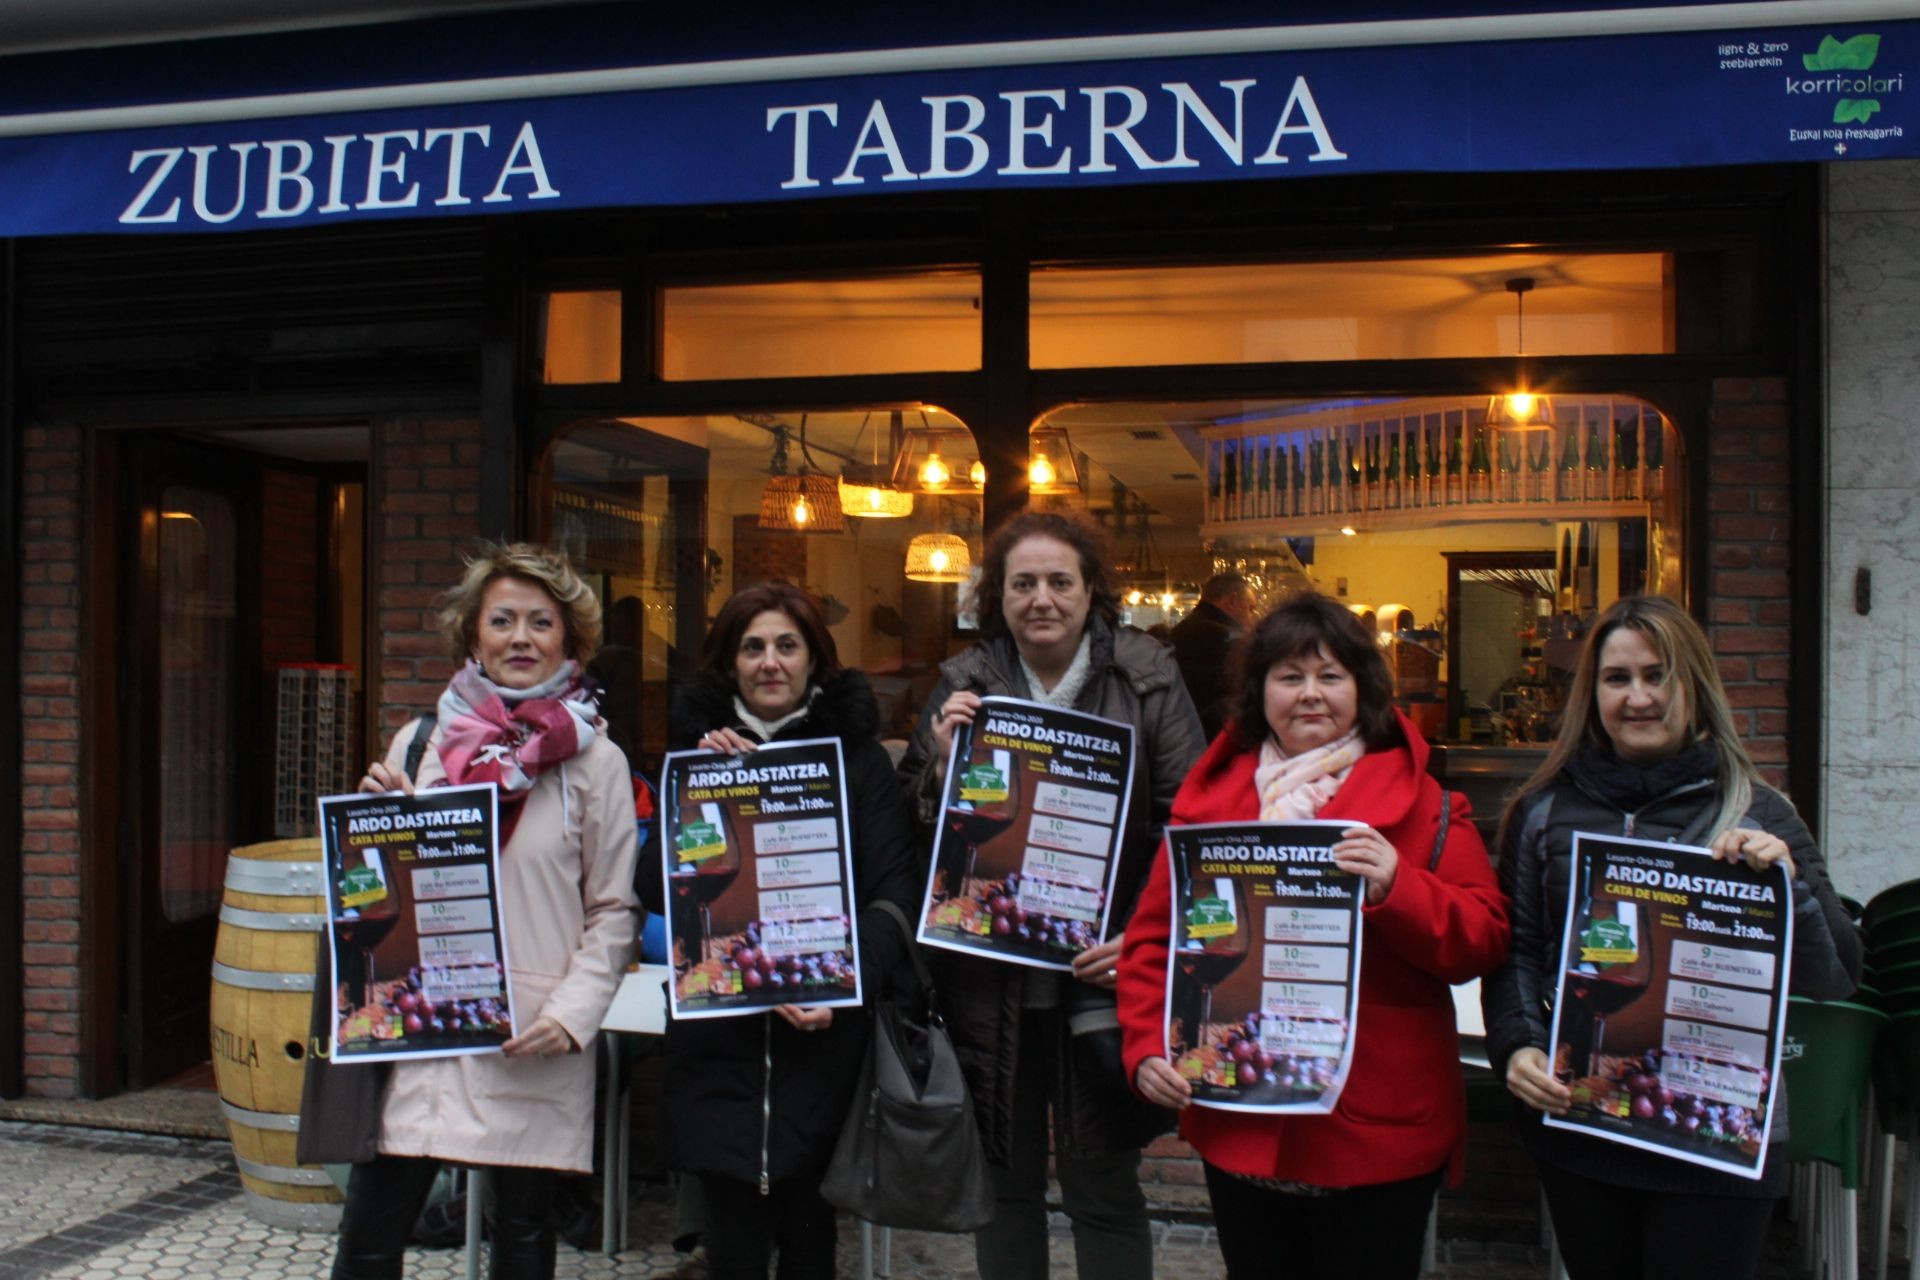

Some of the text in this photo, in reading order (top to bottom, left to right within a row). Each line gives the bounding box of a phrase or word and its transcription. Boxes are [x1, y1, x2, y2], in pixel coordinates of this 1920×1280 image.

[1718, 42, 1789, 56] light & zero
[1720, 57, 1783, 69] stebiarekin
[1786, 73, 1902, 95] korricolari
[1789, 126, 1902, 142] Euskal kola freskagarria
[118, 75, 1347, 223] ZUBIETA TABERNA
[985, 718, 1121, 755] ARDO DASTATZEA
[983, 734, 1053, 755] CATA DE VINOS
[688, 762, 829, 788] ARDO DASTATZEA
[688, 785, 759, 800] CATA DE VINOS
[349, 808, 482, 834] ARDO DASTATZEA
[1049, 820, 1063, 831] 10
[350, 831, 416, 846] CATA DE VINOS
[1043, 852, 1055, 863] 11
[1200, 845, 1335, 862] ARDO DASTATZ
[775, 858, 789, 868] 10
[1201, 863, 1277, 875] CATA DE VINOS
[1605, 864, 1775, 903] ARDO DASTATZEA
[777, 892, 790, 902] 11
[1605, 883, 1688, 906] CATA DE VINOS
[431, 903, 445, 914] 10
[435, 938, 448, 948] 11
[1284, 947, 1299, 959] 10
[1701, 946, 1711, 958] 9
[1282, 985, 1295, 996] 11
[1691, 985, 1709, 999] 10
[1280, 1022, 1294, 1033] 12
[1687, 1024, 1703, 1036] 11
[1684, 1061, 1701, 1073] 12
